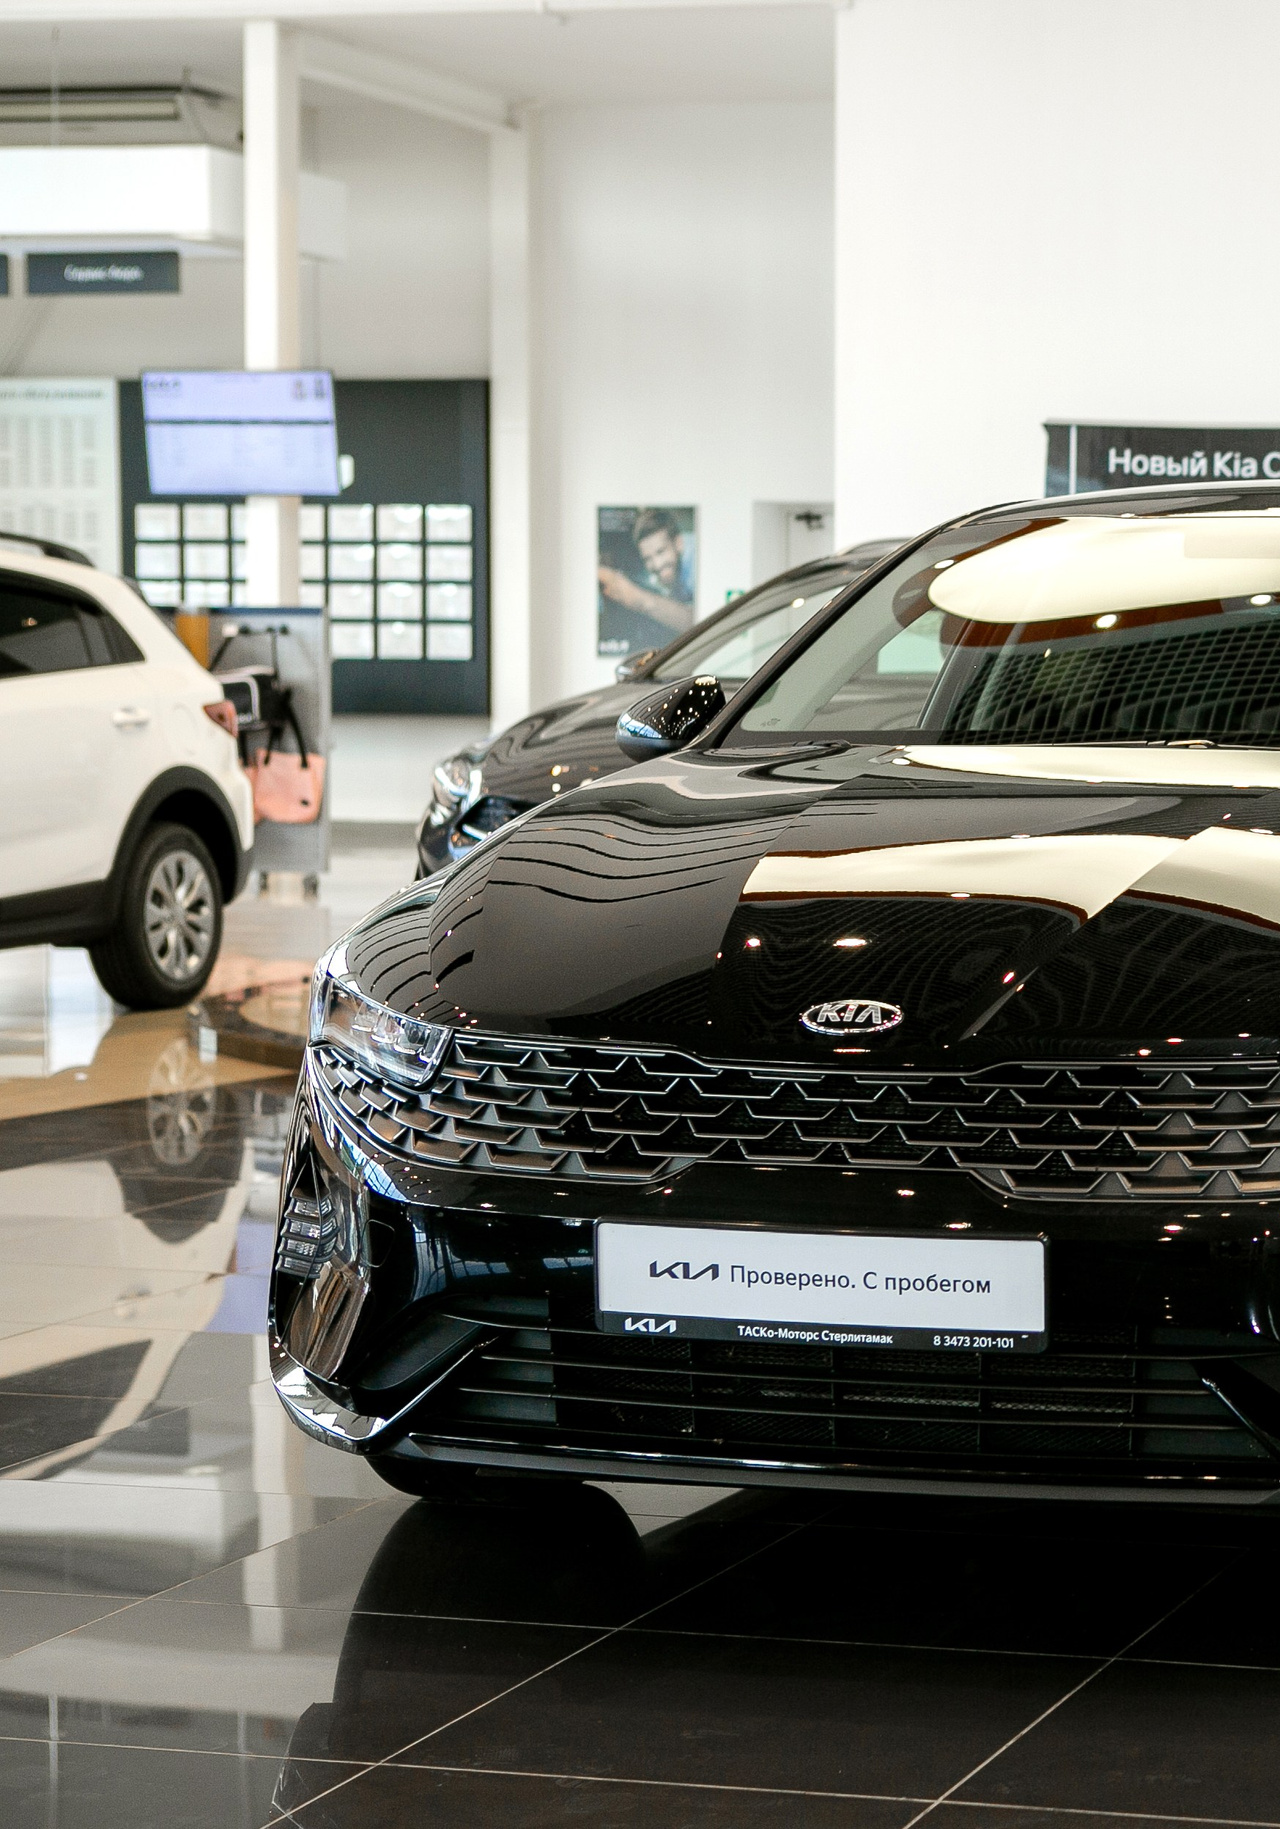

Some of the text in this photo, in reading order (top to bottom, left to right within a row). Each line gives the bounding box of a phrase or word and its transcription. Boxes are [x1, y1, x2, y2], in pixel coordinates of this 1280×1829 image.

[1108, 447, 1208, 478] Новый
[1212, 451, 1258, 479] Kia
[816, 1004, 883, 1024] KIA
[649, 1260, 992, 1296] KIA Проверено. С пробегом
[624, 1317, 677, 1334] KIA
[737, 1325, 894, 1345] ТАСКо-Моторс Стерлитамак
[933, 1335, 1014, 1348] 8 3473 201-101
